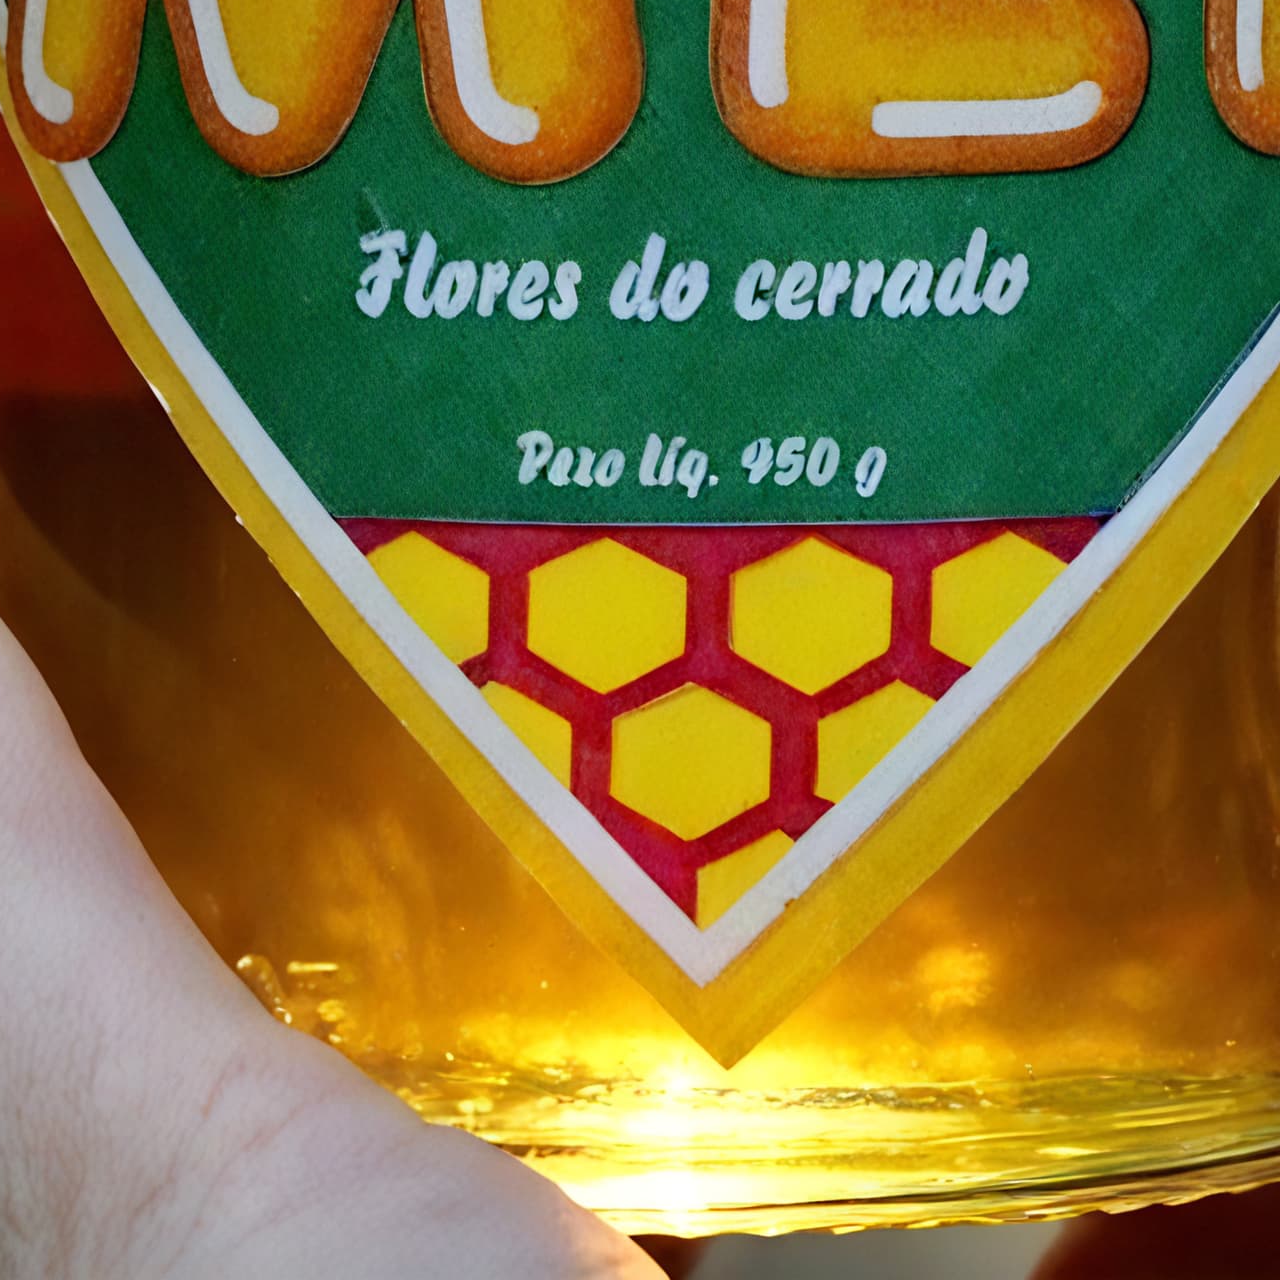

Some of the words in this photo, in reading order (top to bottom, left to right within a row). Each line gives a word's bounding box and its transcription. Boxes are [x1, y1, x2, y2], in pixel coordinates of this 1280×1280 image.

[355, 230, 582, 320] Flores
[609, 233, 710, 322] do
[734, 226, 1030, 321] cerrado
